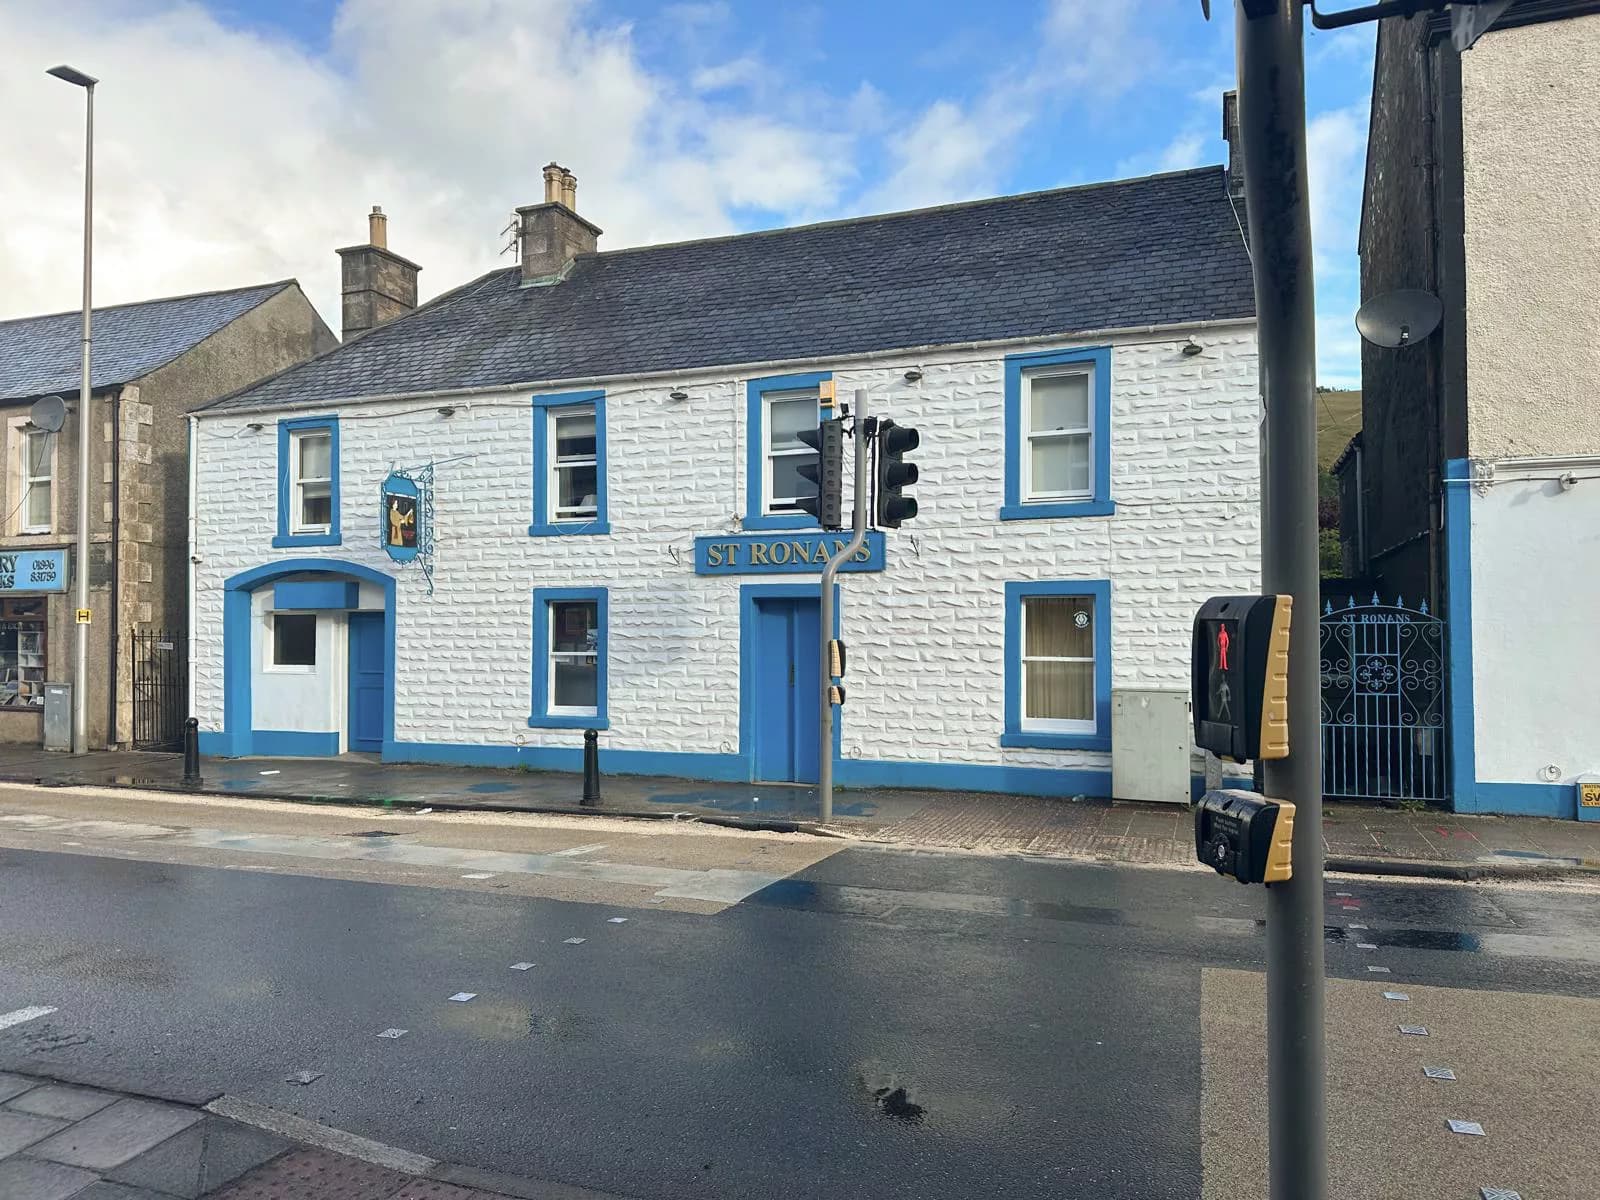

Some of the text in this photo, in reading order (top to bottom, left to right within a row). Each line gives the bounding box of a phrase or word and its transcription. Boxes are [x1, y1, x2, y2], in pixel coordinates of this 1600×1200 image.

[707, 543, 740, 567] ST
[78, 611, 89, 622] H
[1342, 613, 1411, 624] ST RONANS
